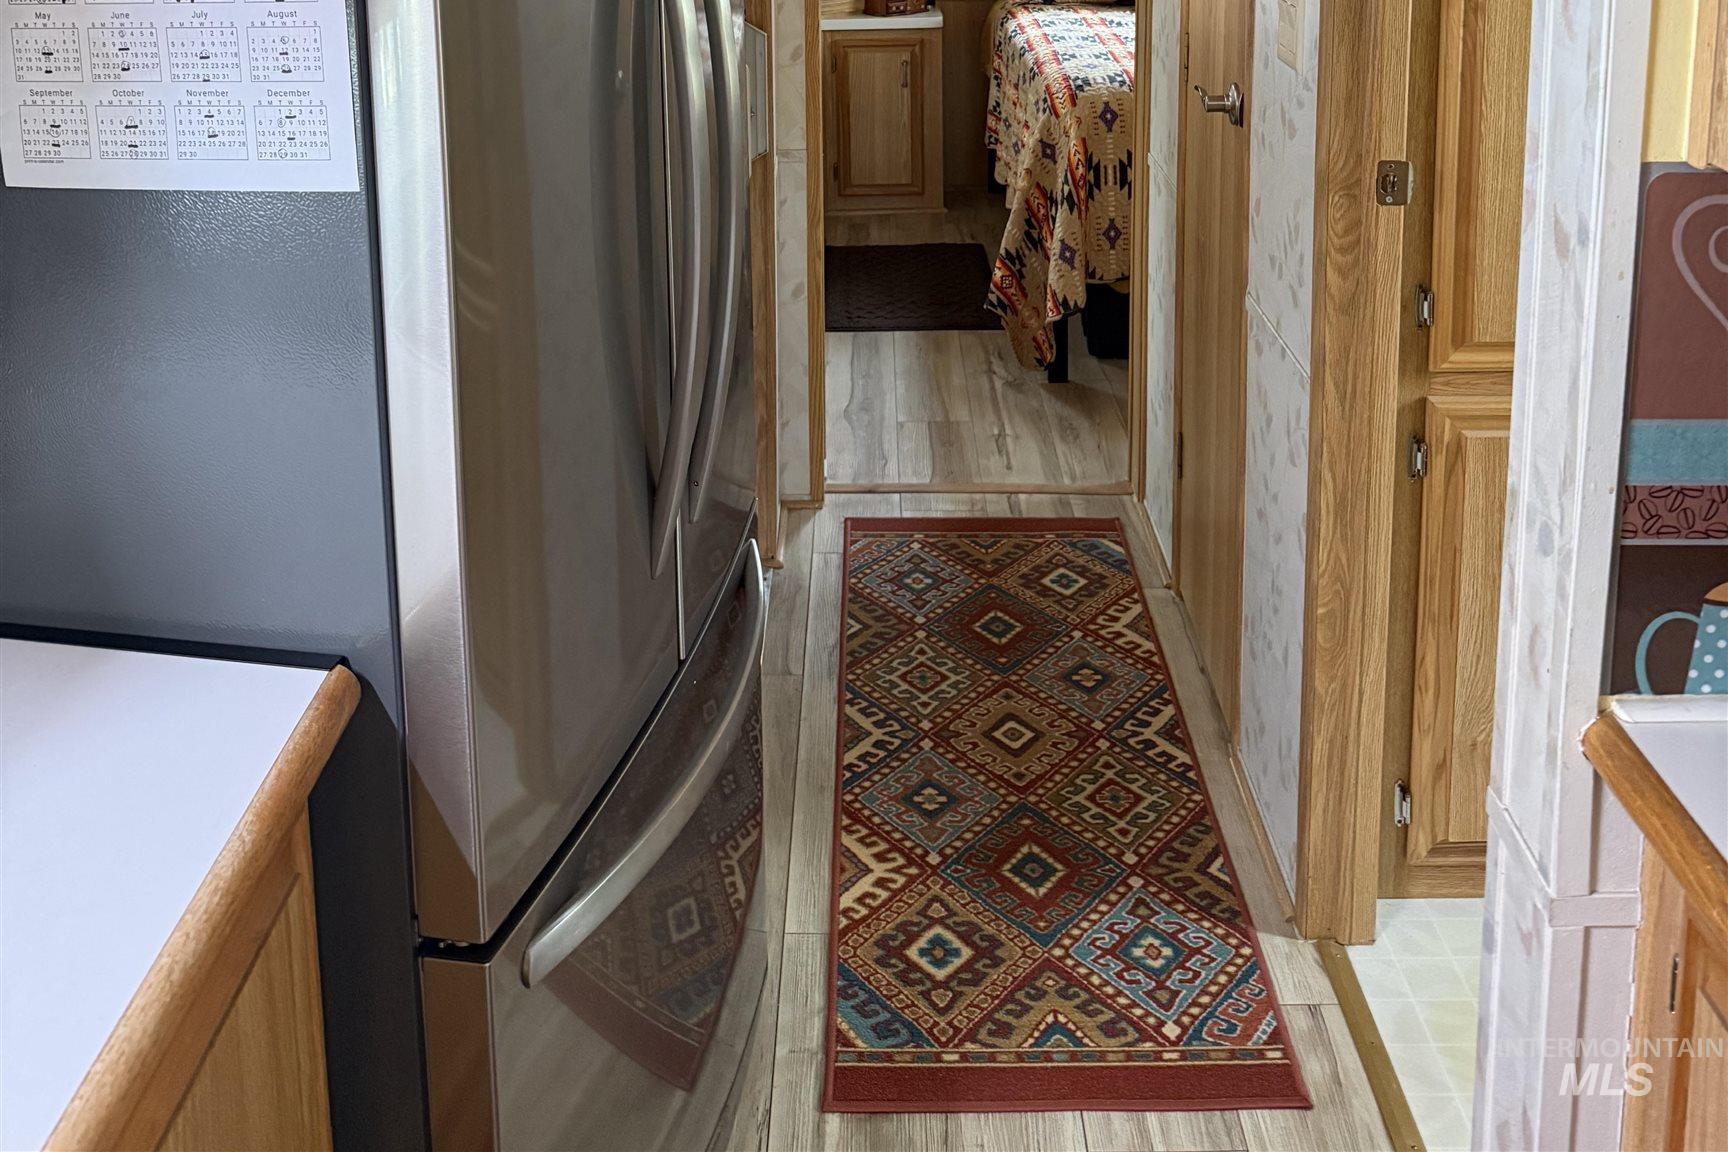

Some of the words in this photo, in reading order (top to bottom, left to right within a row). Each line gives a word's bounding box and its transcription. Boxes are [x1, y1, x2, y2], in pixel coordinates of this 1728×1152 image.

[35, 12, 50, 21] May
[192, 10, 208, 20] July
[267, 10, 297, 19] August
[30, 89, 72, 98] September
